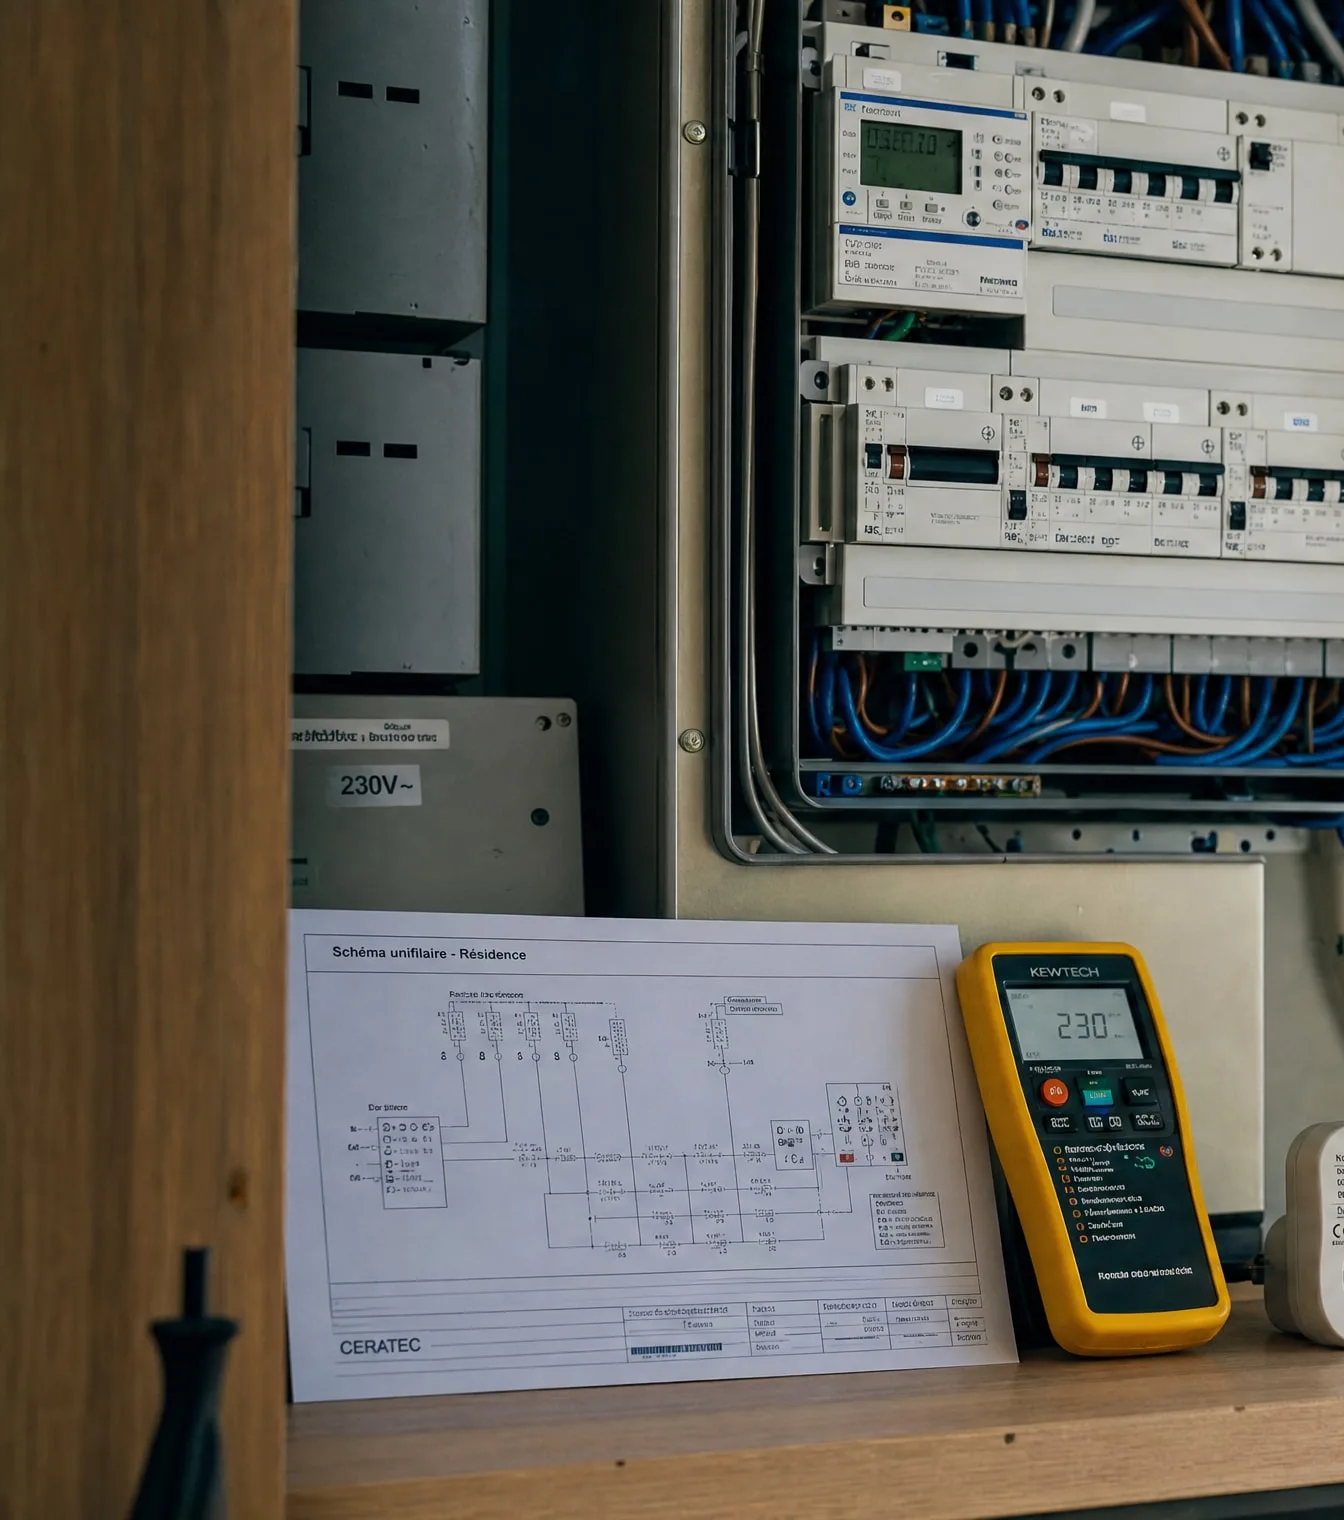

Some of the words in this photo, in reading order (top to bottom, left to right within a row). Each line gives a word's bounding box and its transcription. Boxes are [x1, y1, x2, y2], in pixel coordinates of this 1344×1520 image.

[340, 774, 413, 796] 230V~
[332, 945, 386, 958] Schéma
[390, 946, 447, 959] unifilaire
[459, 947, 527, 961] Résidence
[1029, 967, 1100, 978] KEWTECH
[1056, 1012, 1108, 1040] 230
[339, 1337, 421, 1355] CERATEC
